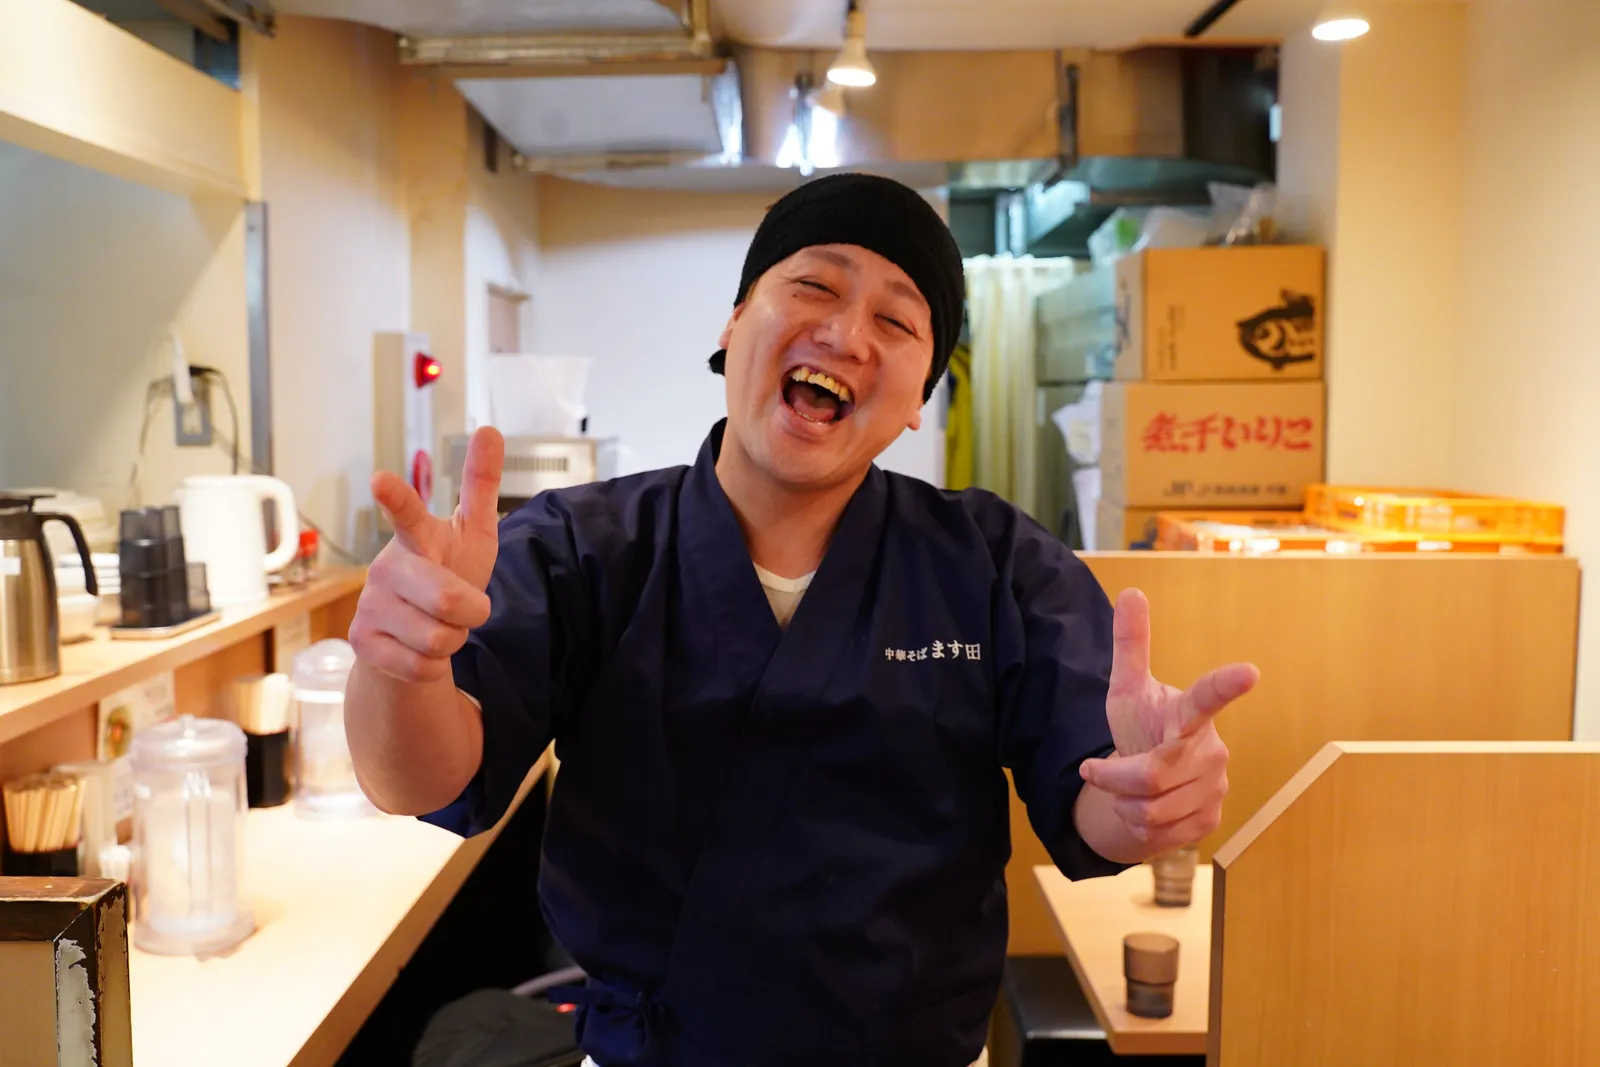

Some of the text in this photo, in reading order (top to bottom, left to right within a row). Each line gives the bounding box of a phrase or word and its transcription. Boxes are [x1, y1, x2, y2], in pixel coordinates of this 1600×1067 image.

[885, 640, 981, 661] 中華そば ます田
